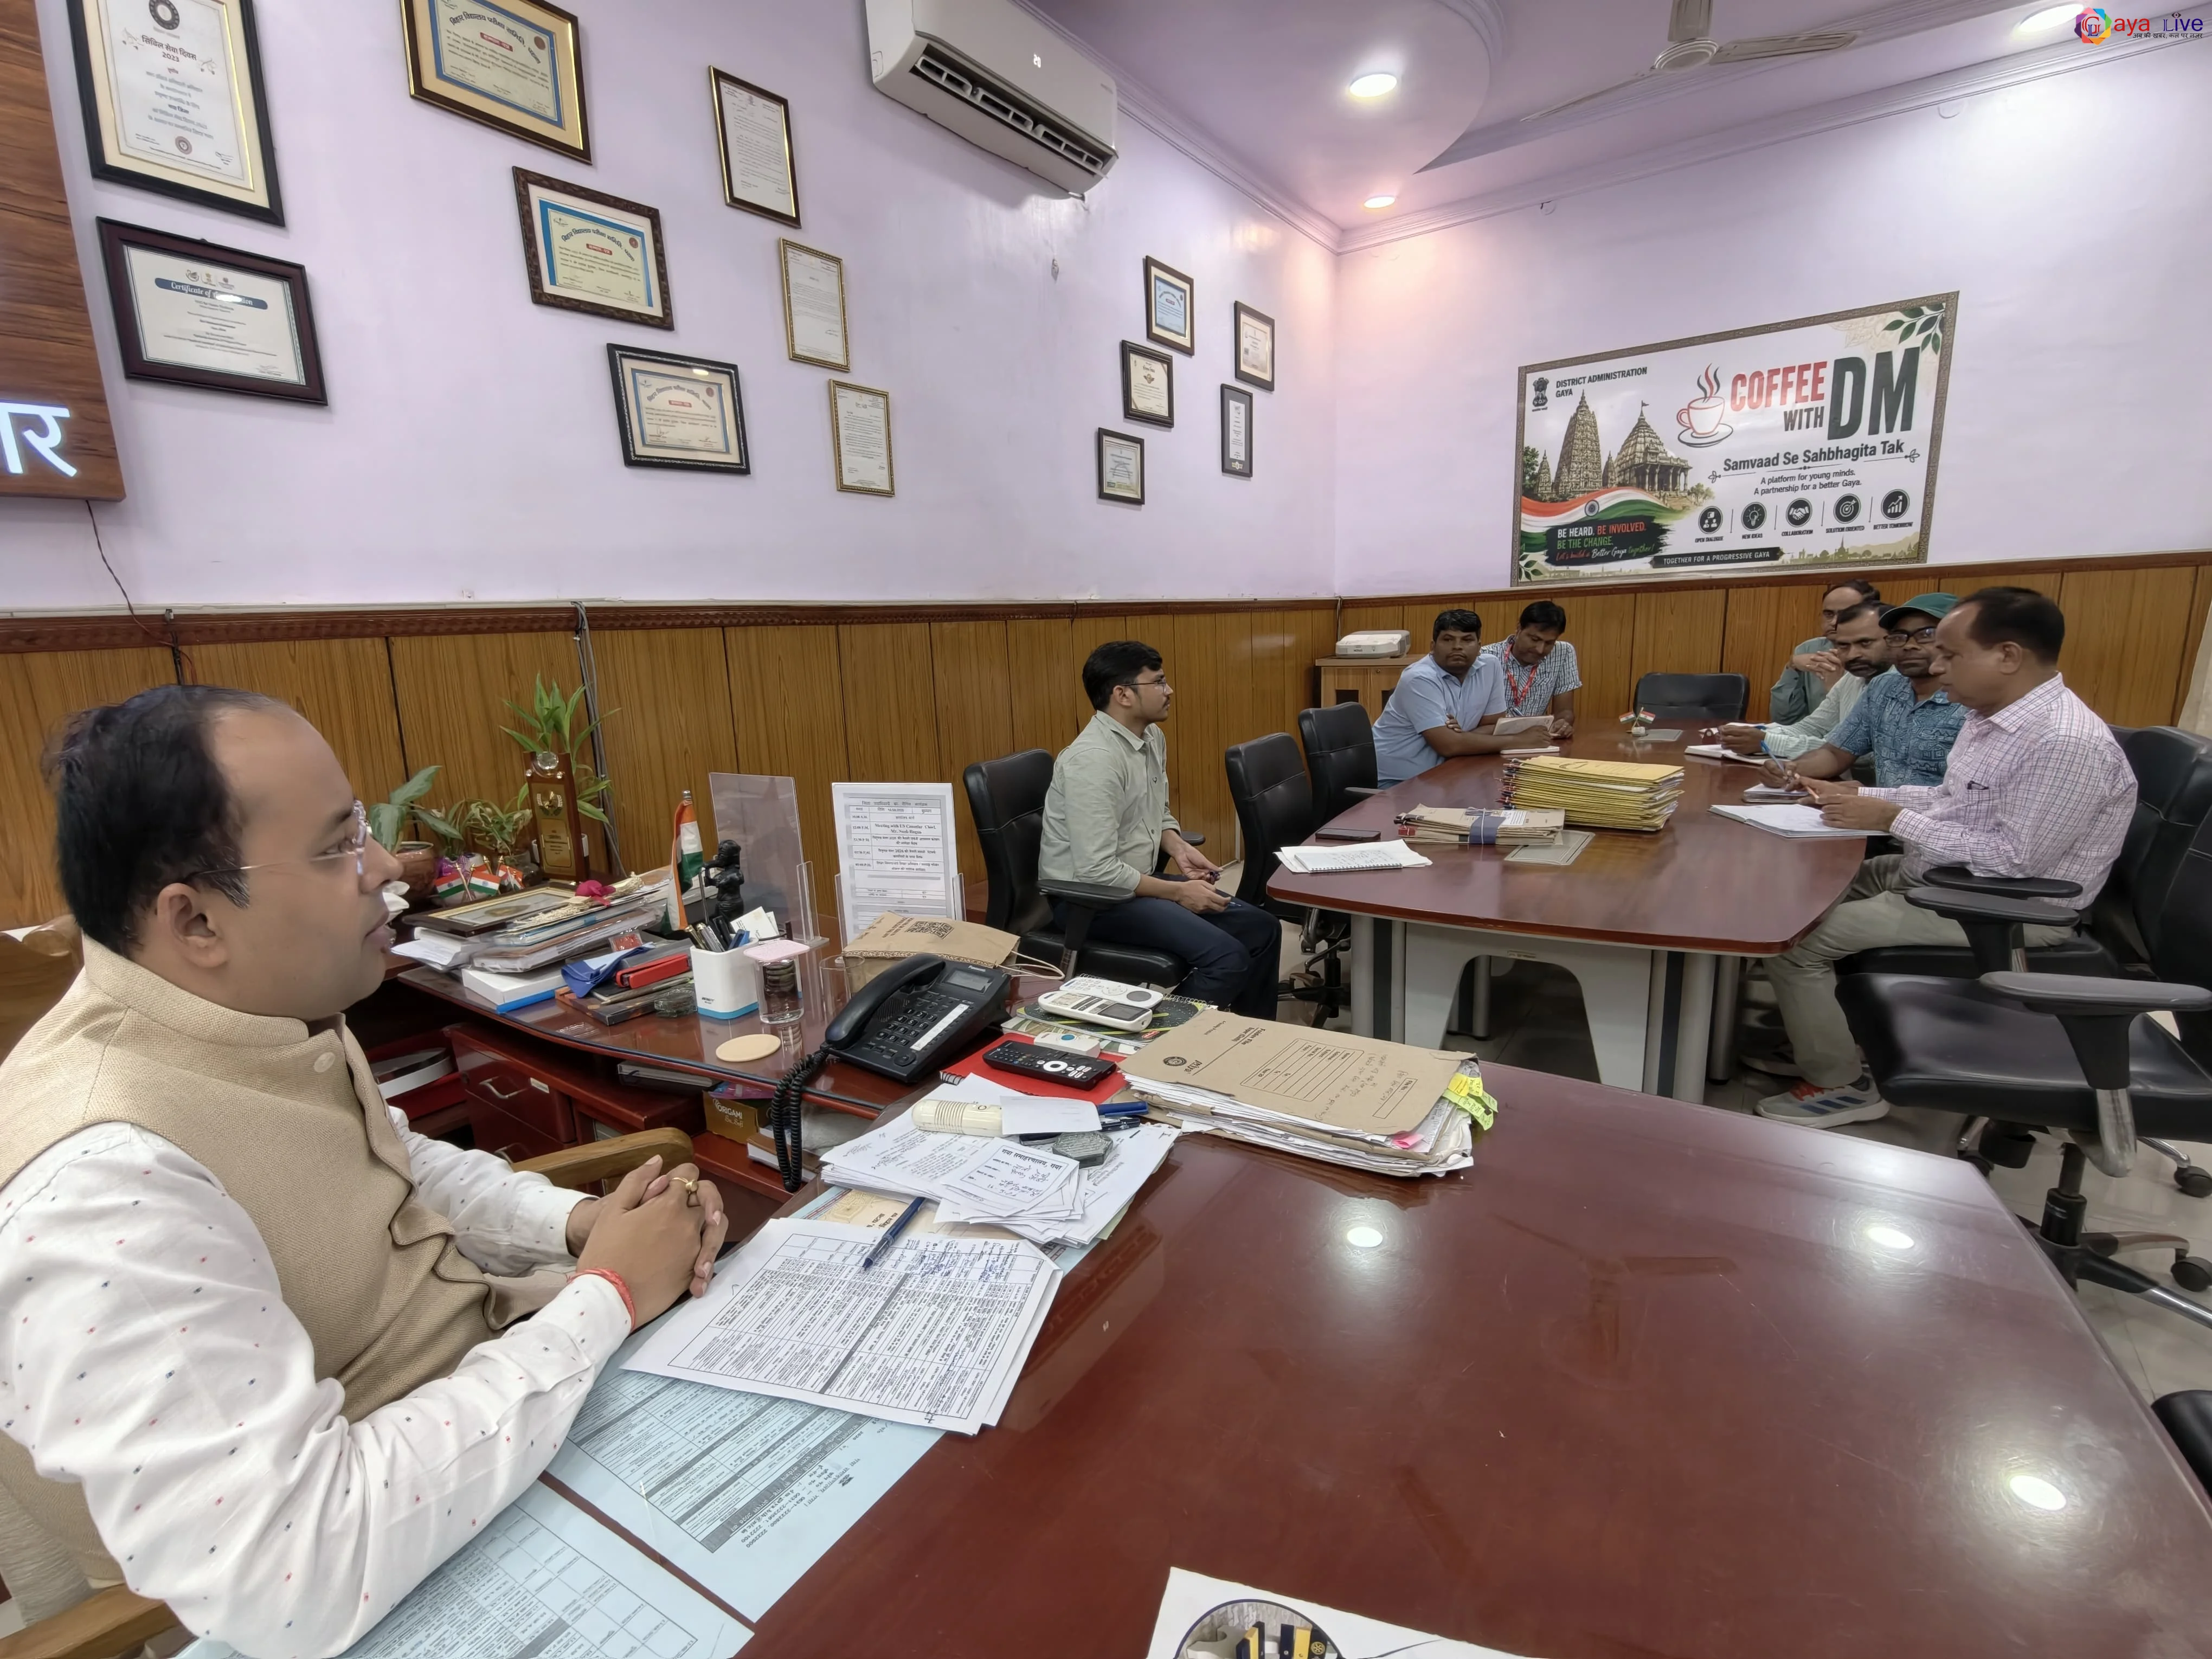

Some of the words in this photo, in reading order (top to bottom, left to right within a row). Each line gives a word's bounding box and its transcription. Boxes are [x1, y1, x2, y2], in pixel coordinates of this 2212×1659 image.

[162, 52, 179, 62] 2023
[165, 43, 178, 54] सेवा
[179, 48, 197, 61] दिवस
[171, 281, 203, 294] Certificate
[205, 290, 211, 298] of
[1556, 376, 1587, 388] DISTRICT
[1587, 366, 1648, 383] ADMINISTRATION
[1555, 389, 1573, 397] GAYA
[1731, 361, 1828, 411] COFFEE
[1783, 406, 1825, 432] WITH
[1828, 346, 1920, 440] DM
[1723, 453, 1780, 472] Samvaad
[1783, 452, 1799, 465] Se
[1803, 443, 1877, 463] Sahbhagita
[1880, 439, 1905, 455] Tak
[1760, 477, 1766, 485] A
[1767, 474, 1796, 485] platform
[1798, 472, 1808, 481] for
[1809, 470, 1830, 482] young
[1832, 468, 1856, 478] minds.
[1754, 487, 1759, 496] A
[1761, 484, 1799, 496] partnership
[1801, 483, 1811, 491] for
[1819, 480, 1840, 488] better
[1842, 479, 1862, 488] Gaya.
[1558, 529, 1567, 538] BE
[1569, 526, 1595, 537] HEARD,
[1597, 525, 1607, 535] BE
[1609, 522, 1647, 534] INVOLVED.
[1557, 540, 1566, 549] BE
[1569, 538, 1581, 548] THE
[1584, 536, 1613, 547] CHANGE.
[1592, 548, 1611, 558] Better
[1611, 546, 1627, 558] Gaya
[1664, 556, 1692, 565] TOGETHER
[1713, 552, 1753, 561] PROGRESSIVE
[1013, 1152, 1048, 1168] समाहरणालय,
